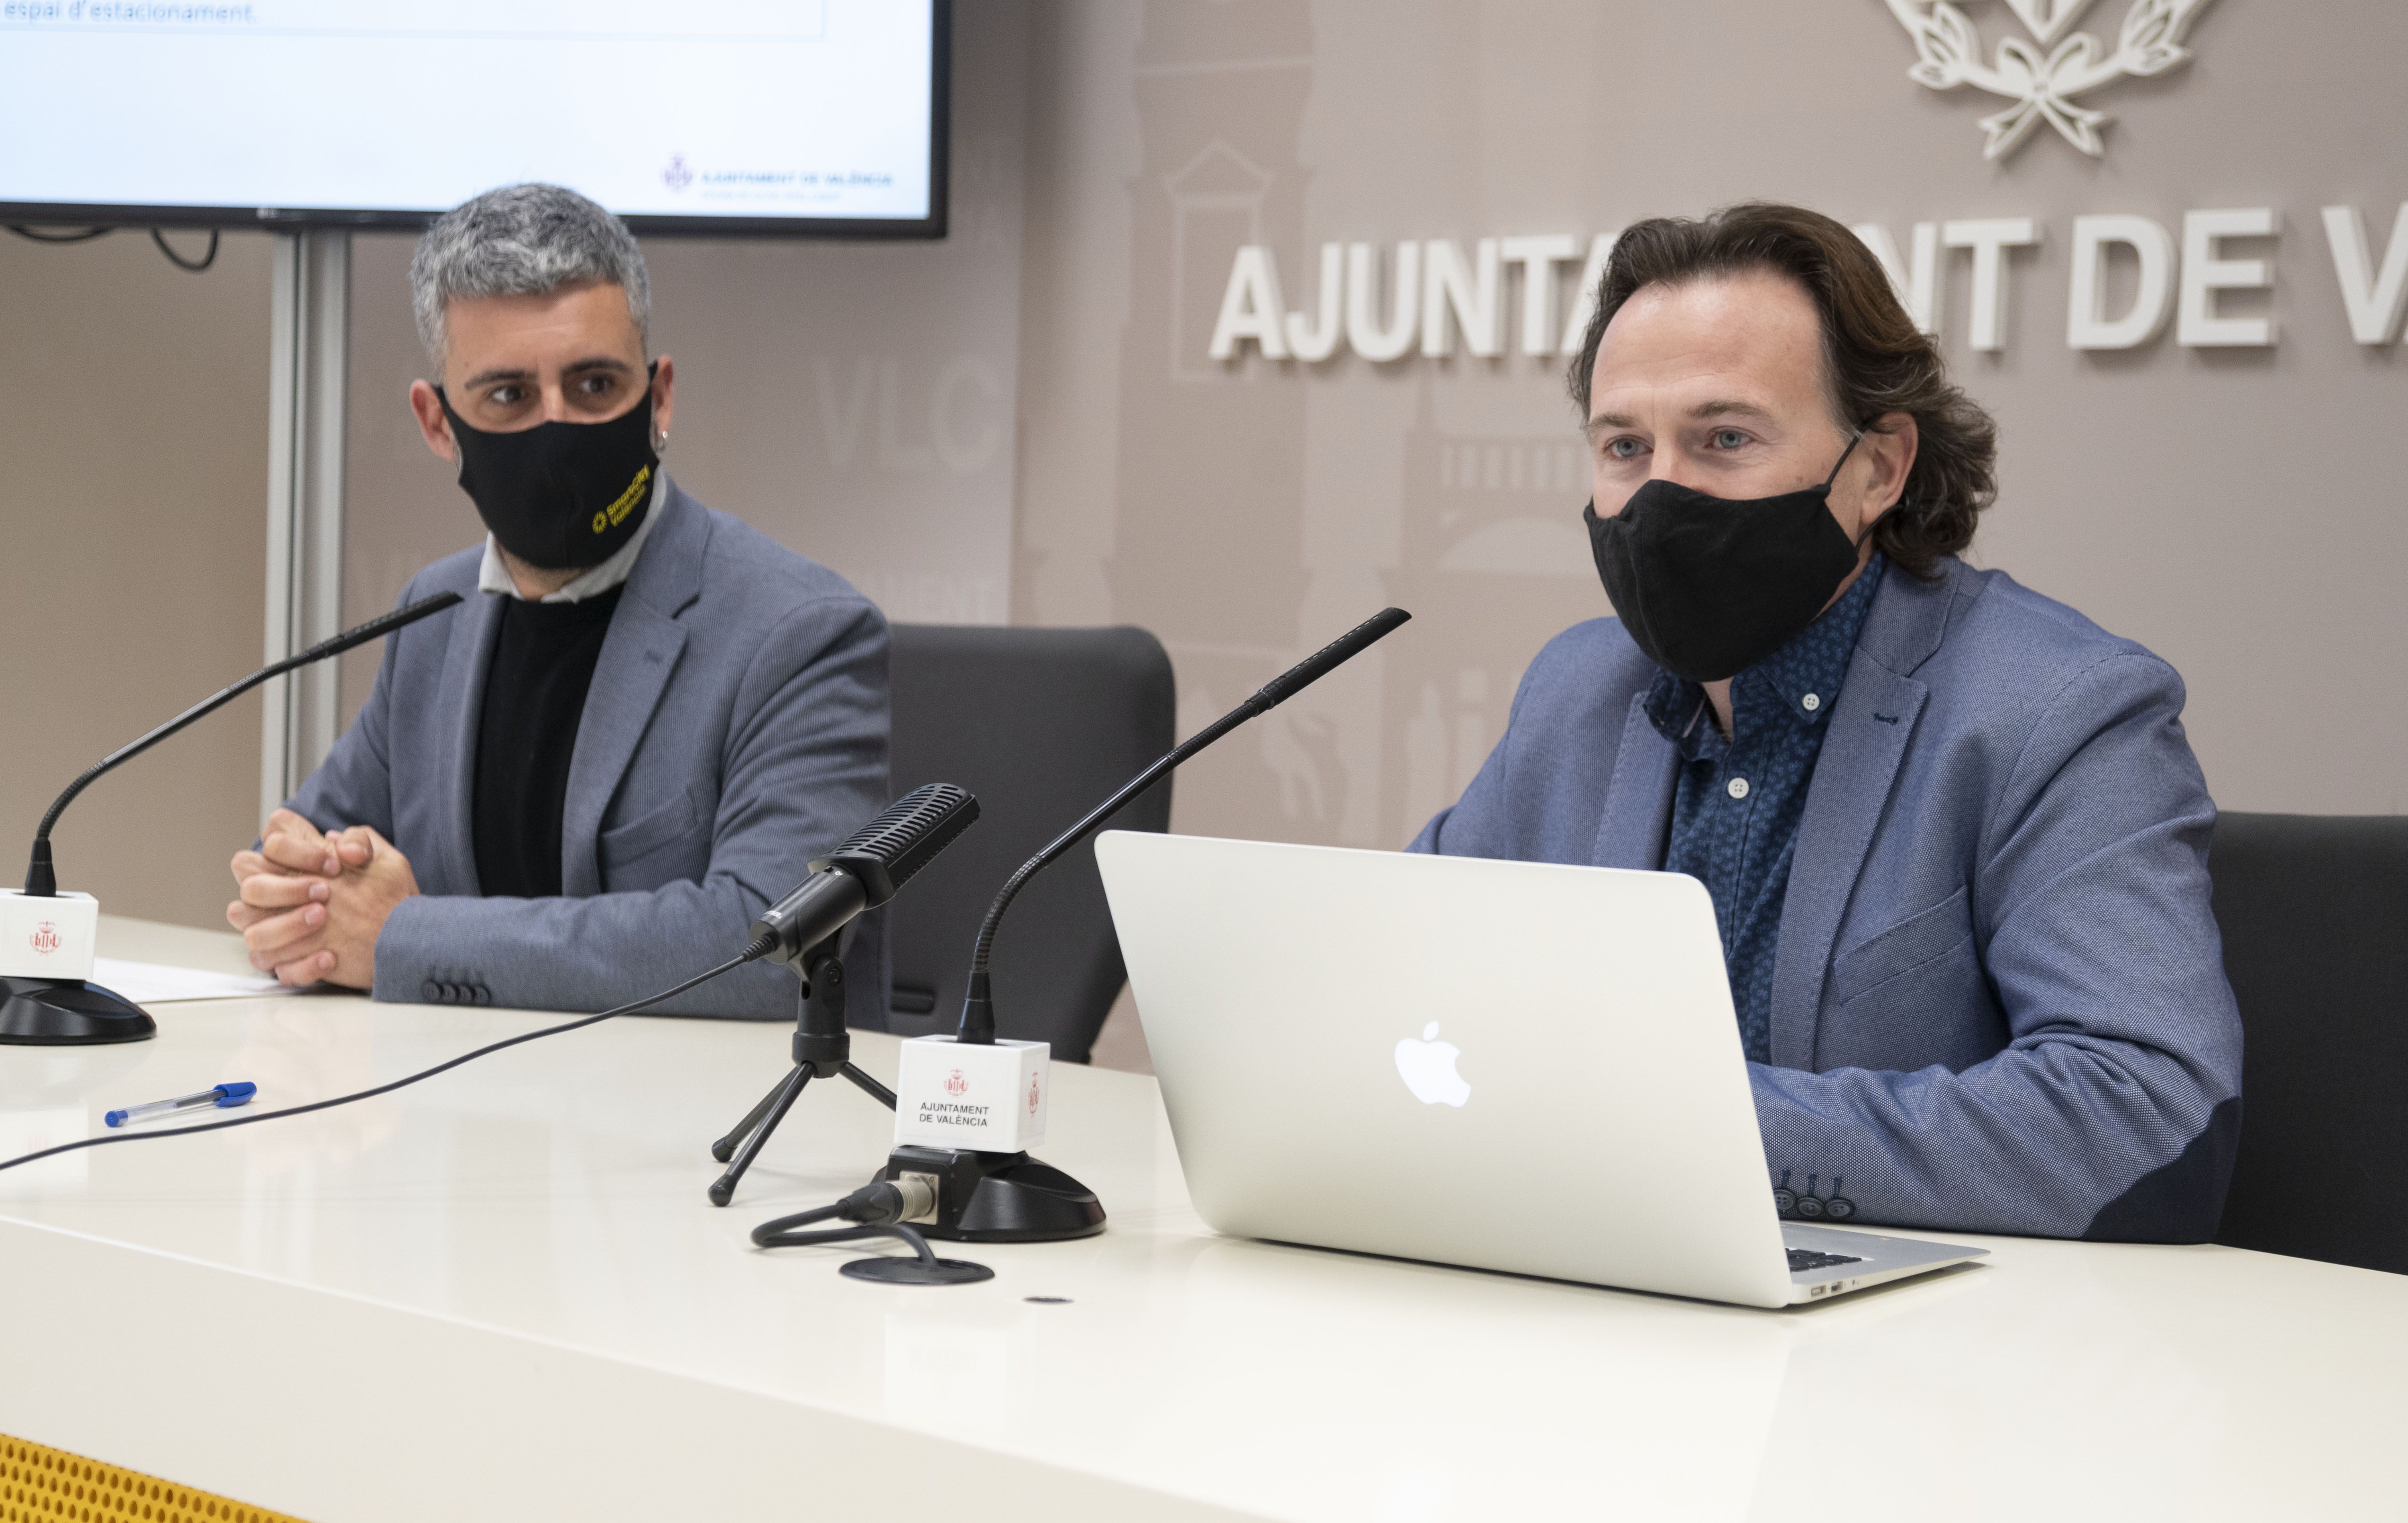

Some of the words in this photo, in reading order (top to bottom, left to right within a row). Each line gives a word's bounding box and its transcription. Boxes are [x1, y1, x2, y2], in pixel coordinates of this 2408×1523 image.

[4, 1, 60, 24] espai
[1209, 218, 2041, 362] AJUNTNT
[2066, 207, 2276, 350] DE
[920, 1102, 989, 1115] AJUNTAMENT
[919, 1113, 933, 1123] DE
[936, 1115, 988, 1127] VALÈNCIA
